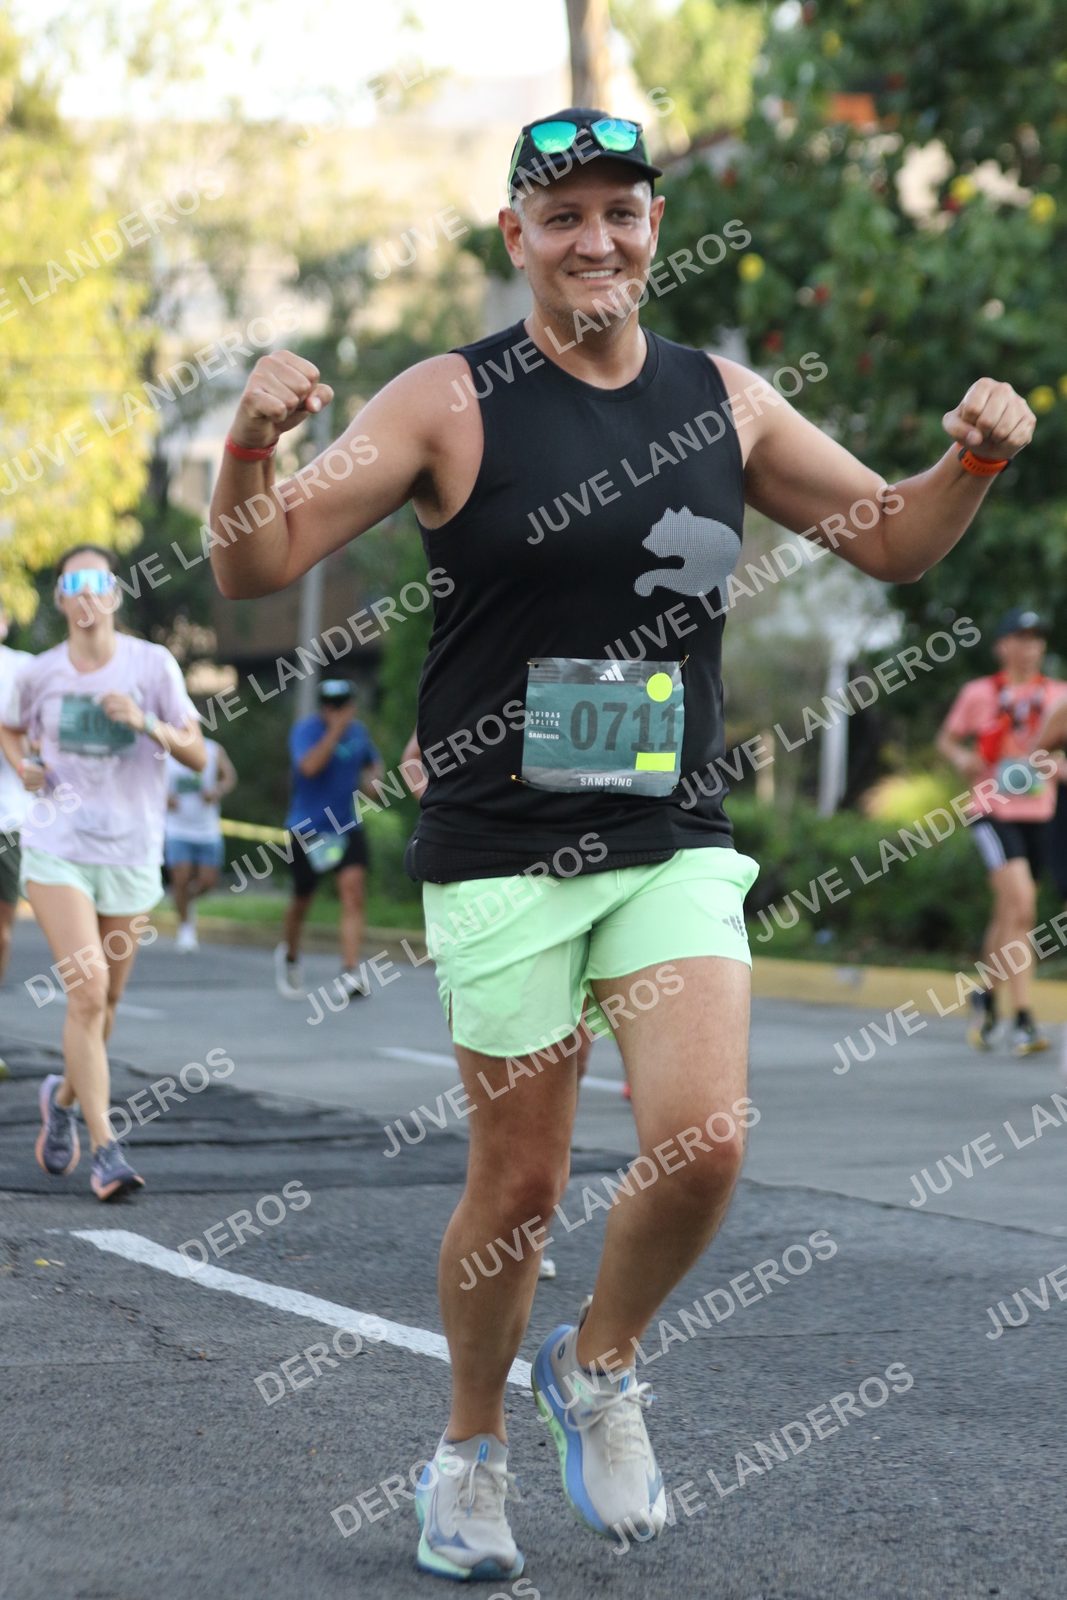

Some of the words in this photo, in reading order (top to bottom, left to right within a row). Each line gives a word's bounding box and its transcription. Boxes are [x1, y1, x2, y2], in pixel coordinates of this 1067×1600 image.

[530, 710, 561, 718] ADIDAS
[530, 719, 560, 727] SPLITS
[570, 700, 678, 751] 0711
[528, 732, 560, 740] SAMSUNG
[580, 776, 632, 787] SAMSUNG
